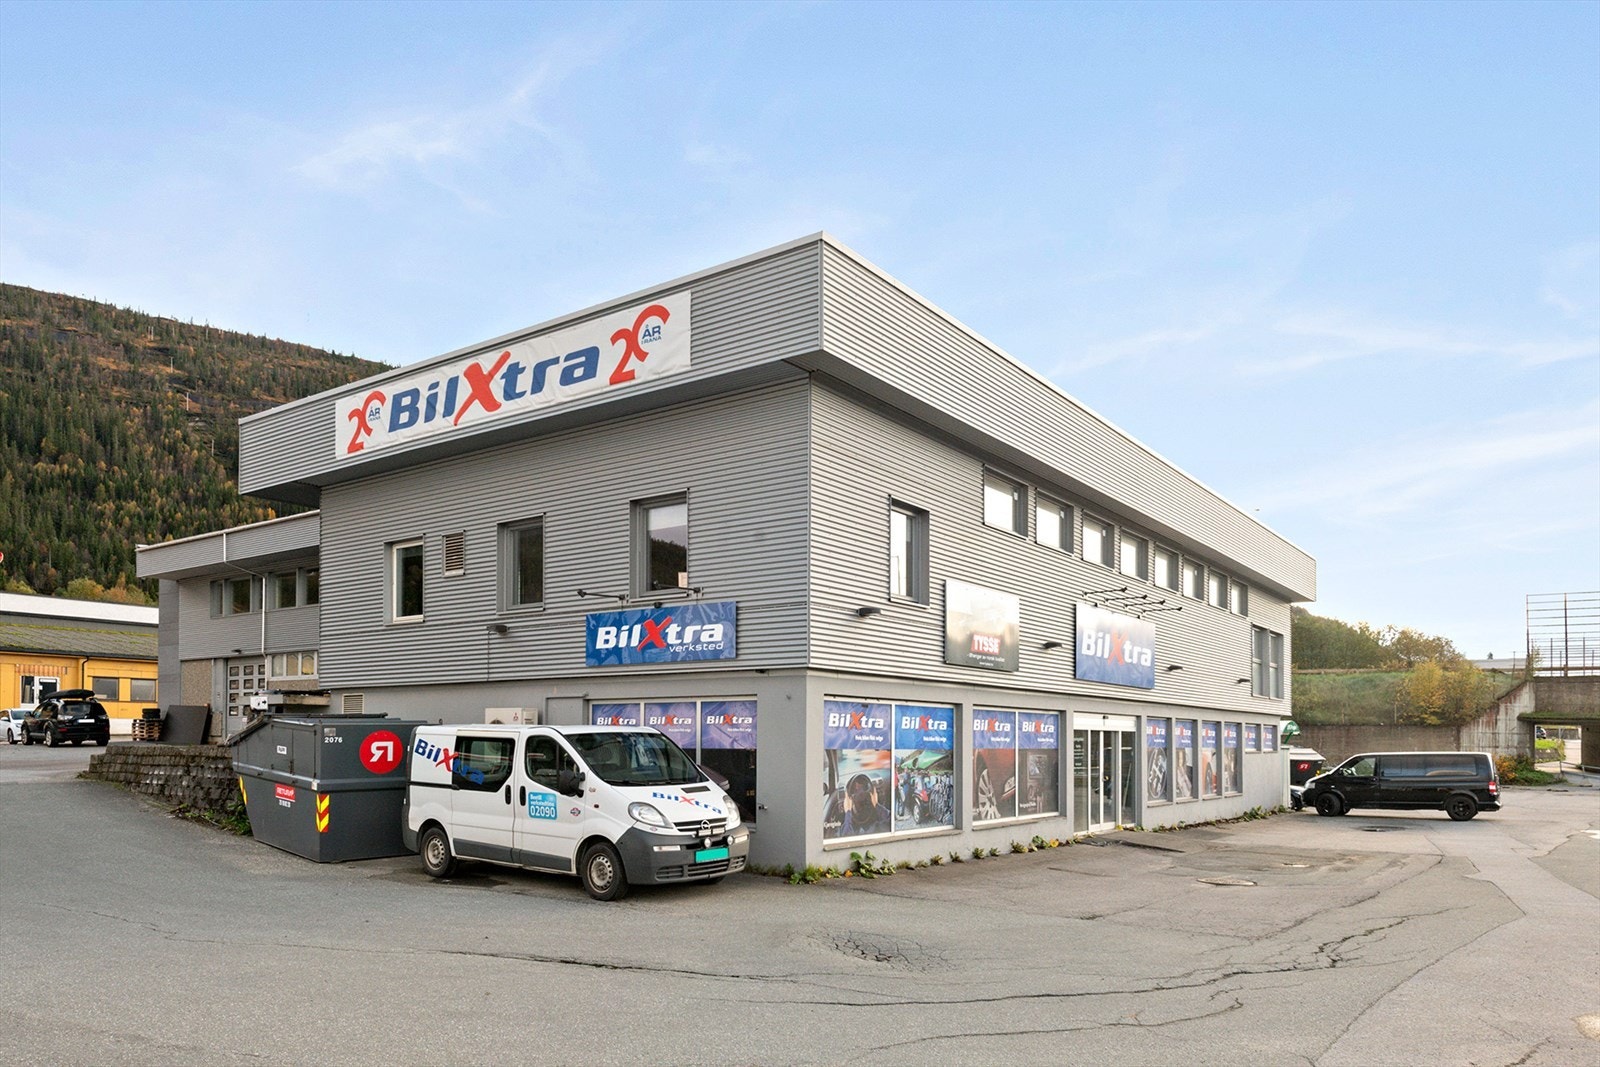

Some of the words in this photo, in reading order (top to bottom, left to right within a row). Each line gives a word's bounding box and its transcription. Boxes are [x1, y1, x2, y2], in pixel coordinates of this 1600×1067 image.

[641, 324, 662, 340] ÅR
[387, 345, 600, 433] BilXtra
[368, 406, 381, 419] ÅR
[595, 615, 724, 652] BilXtra
[669, 641, 724, 652] verksted
[973, 634, 1001, 653] TYSSE
[1081, 628, 1152, 667] BilXtra
[596, 714, 636, 726] BilXtra
[649, 712, 692, 727] BilXtra
[706, 712, 753, 726] BilXtra
[828, 711, 884, 731] BilXtra
[901, 715, 948, 732] BilXtra
[973, 718, 1011, 733] BilXtra
[1022, 719, 1055, 734] BilXtra
[324, 736, 343, 744] 2076
[414, 738, 485, 785] BilXtra
[652, 792, 722, 815] BilXtra
[530, 805, 556, 818] 02090
